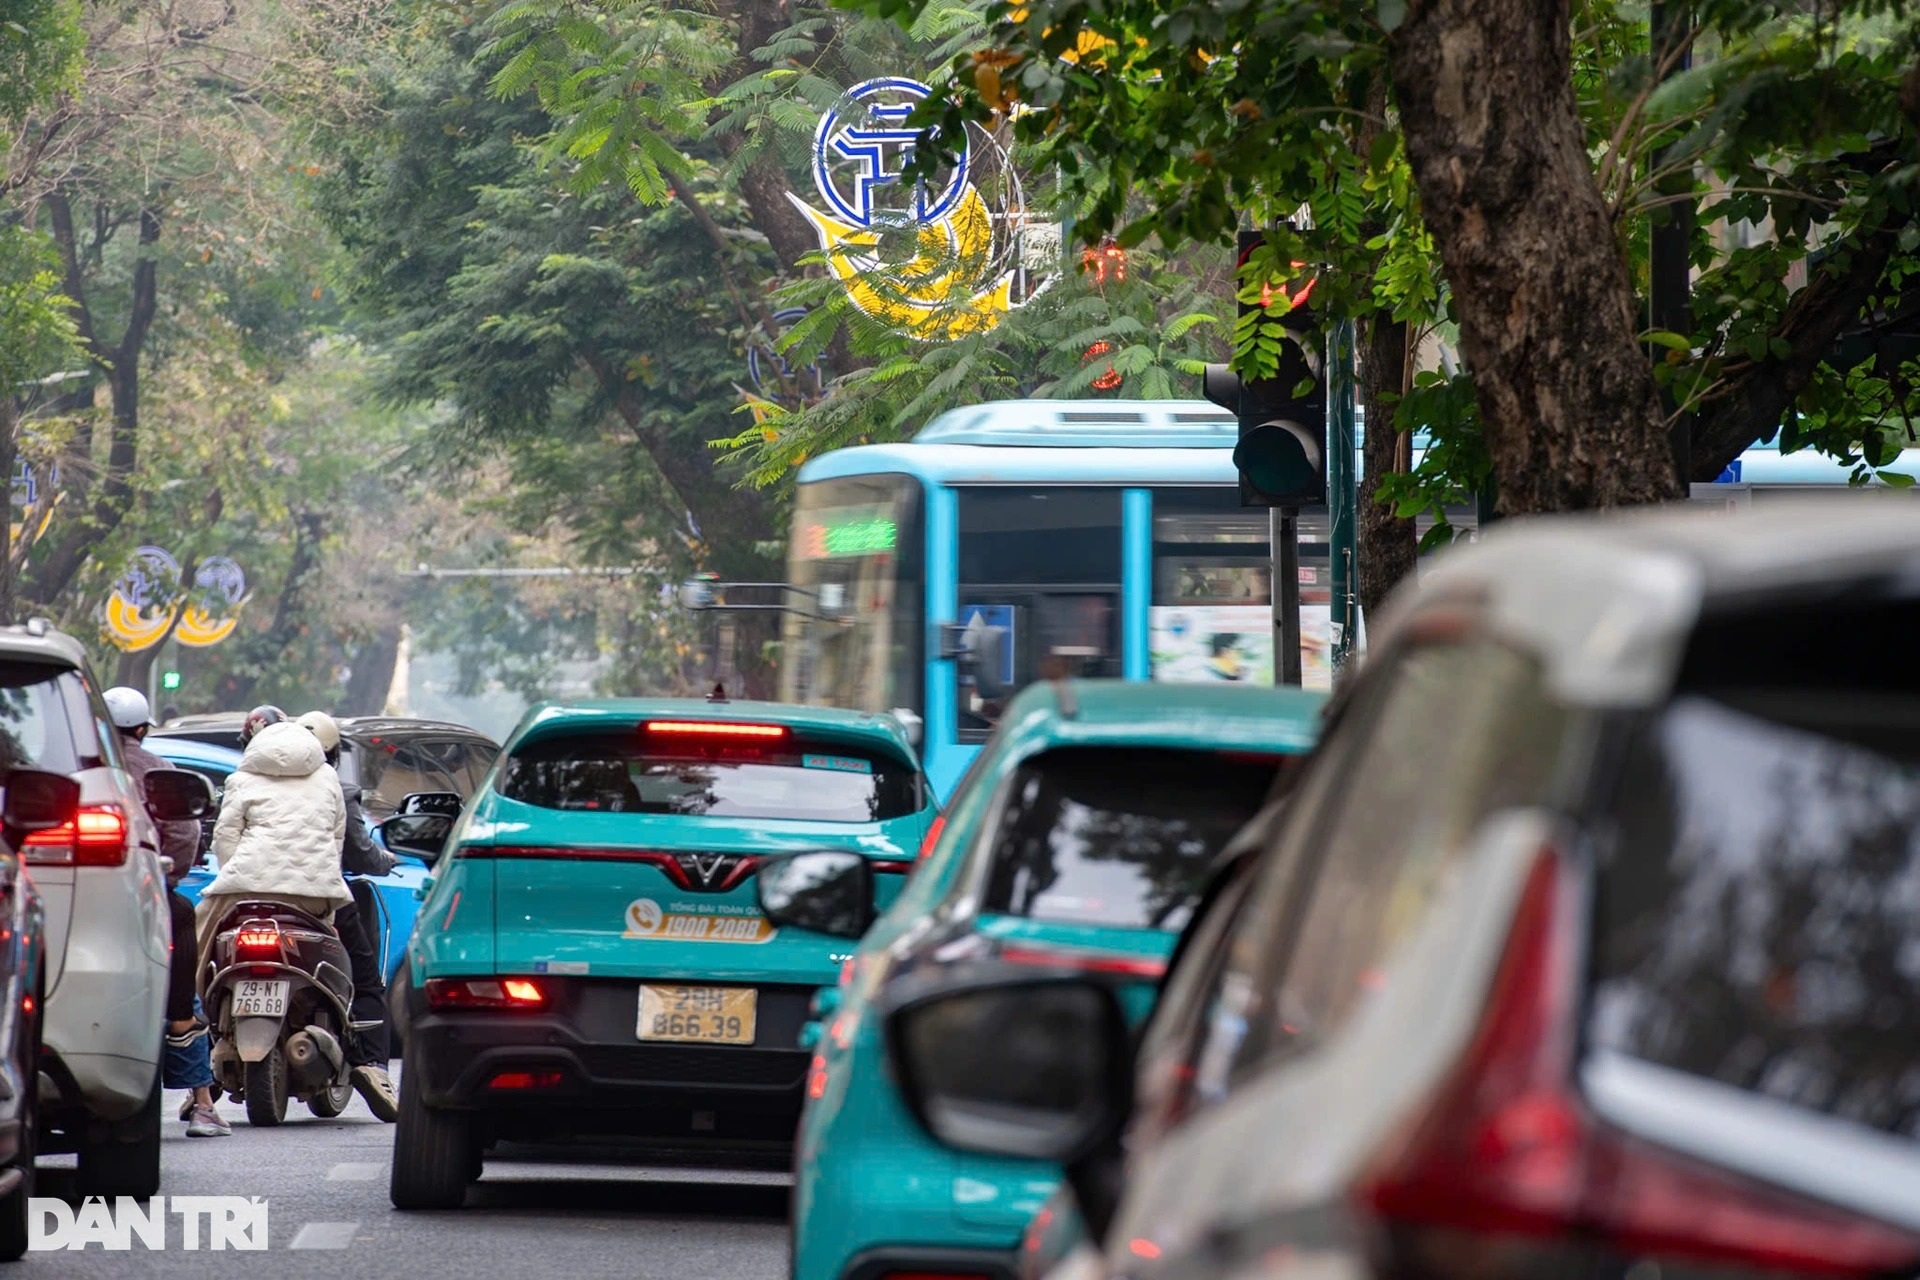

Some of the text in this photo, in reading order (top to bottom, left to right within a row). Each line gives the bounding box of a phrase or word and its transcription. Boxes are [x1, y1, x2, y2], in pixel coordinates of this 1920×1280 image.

[665, 916, 761, 940] 1900 2088
[242, 981, 279, 997] 29-N1
[235, 998, 282, 1014] 766.68
